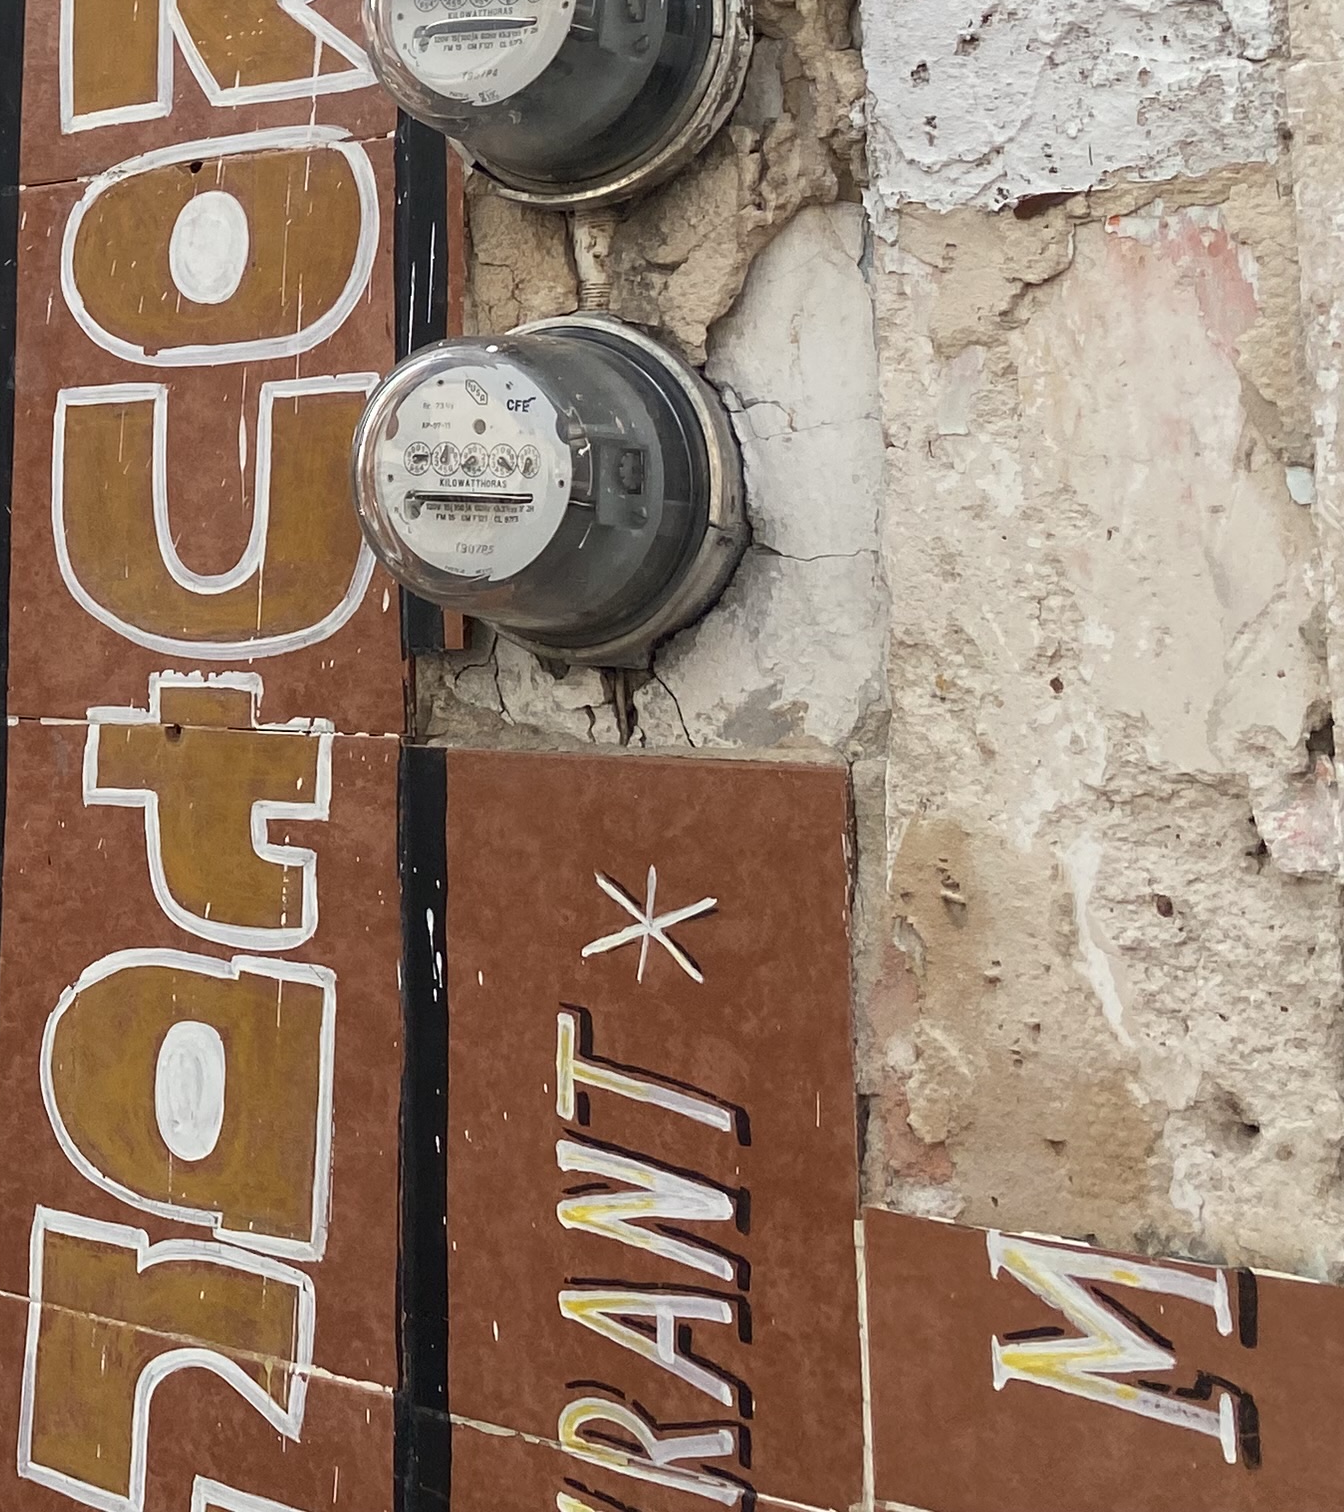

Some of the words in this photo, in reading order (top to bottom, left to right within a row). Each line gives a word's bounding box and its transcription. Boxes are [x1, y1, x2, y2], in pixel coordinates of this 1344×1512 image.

[506, 399, 530, 412] CFE
[439, 478, 507, 489] KILOWATTHORAS
[556, 1010, 739, 1512] RANT
